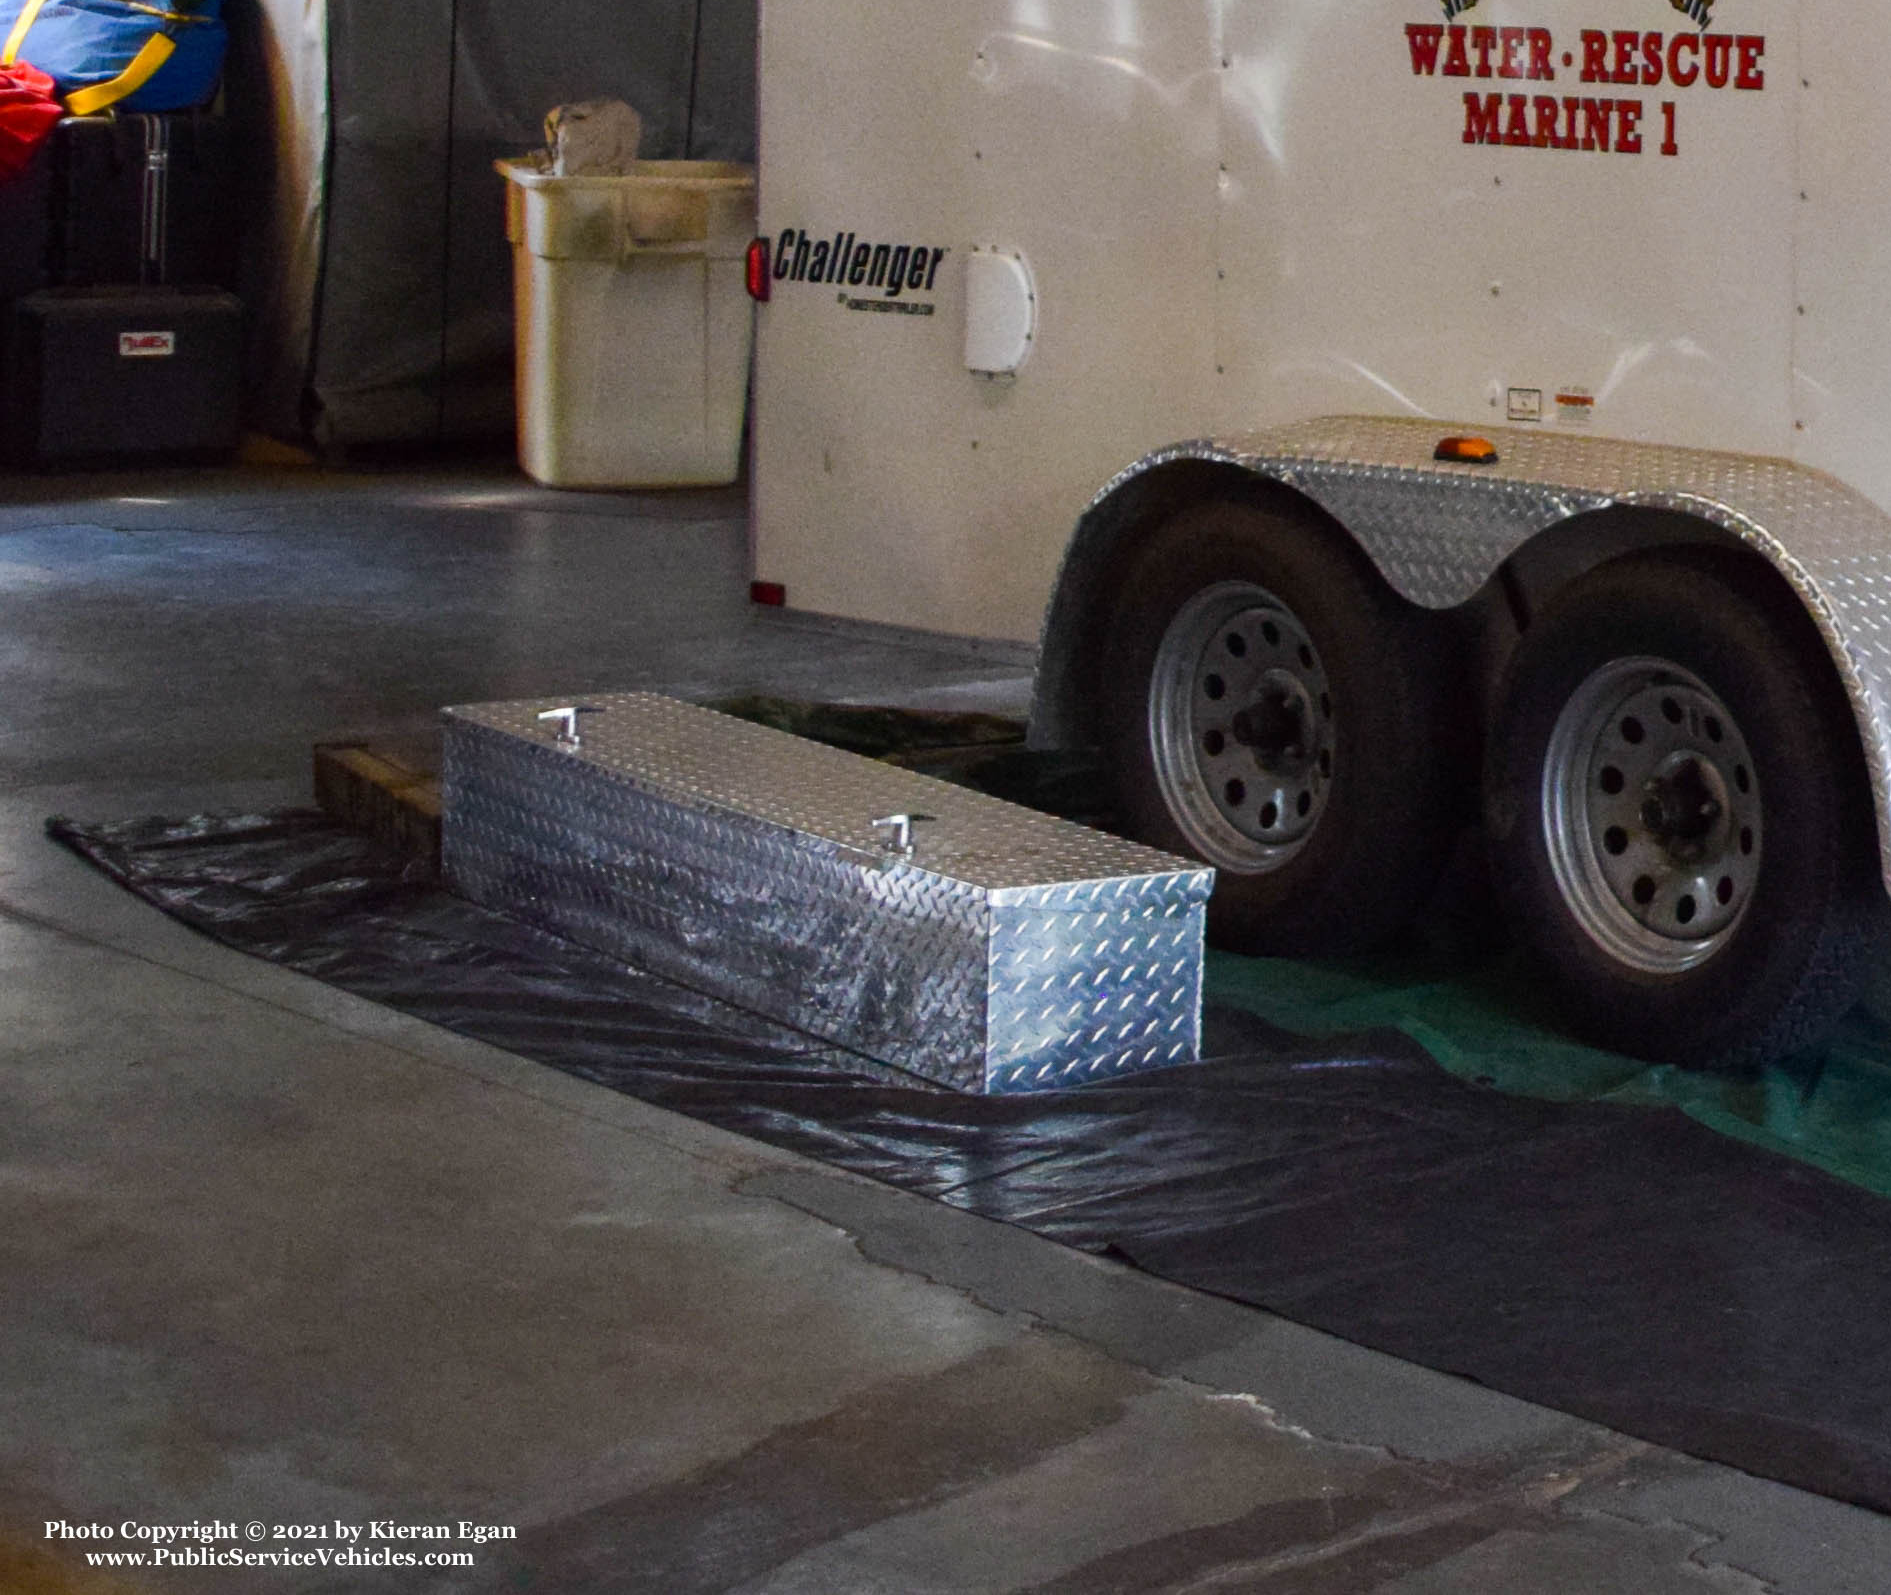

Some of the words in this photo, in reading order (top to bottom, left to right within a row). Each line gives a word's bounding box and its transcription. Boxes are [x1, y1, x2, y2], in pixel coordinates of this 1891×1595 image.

[1404, 22, 1555, 81] WATER
[1579, 29, 1765, 91] RESCUE
[1461, 91, 1643, 156] MARINE
[1660, 100, 1678, 156] 1
[772, 228, 946, 297] Challenger
